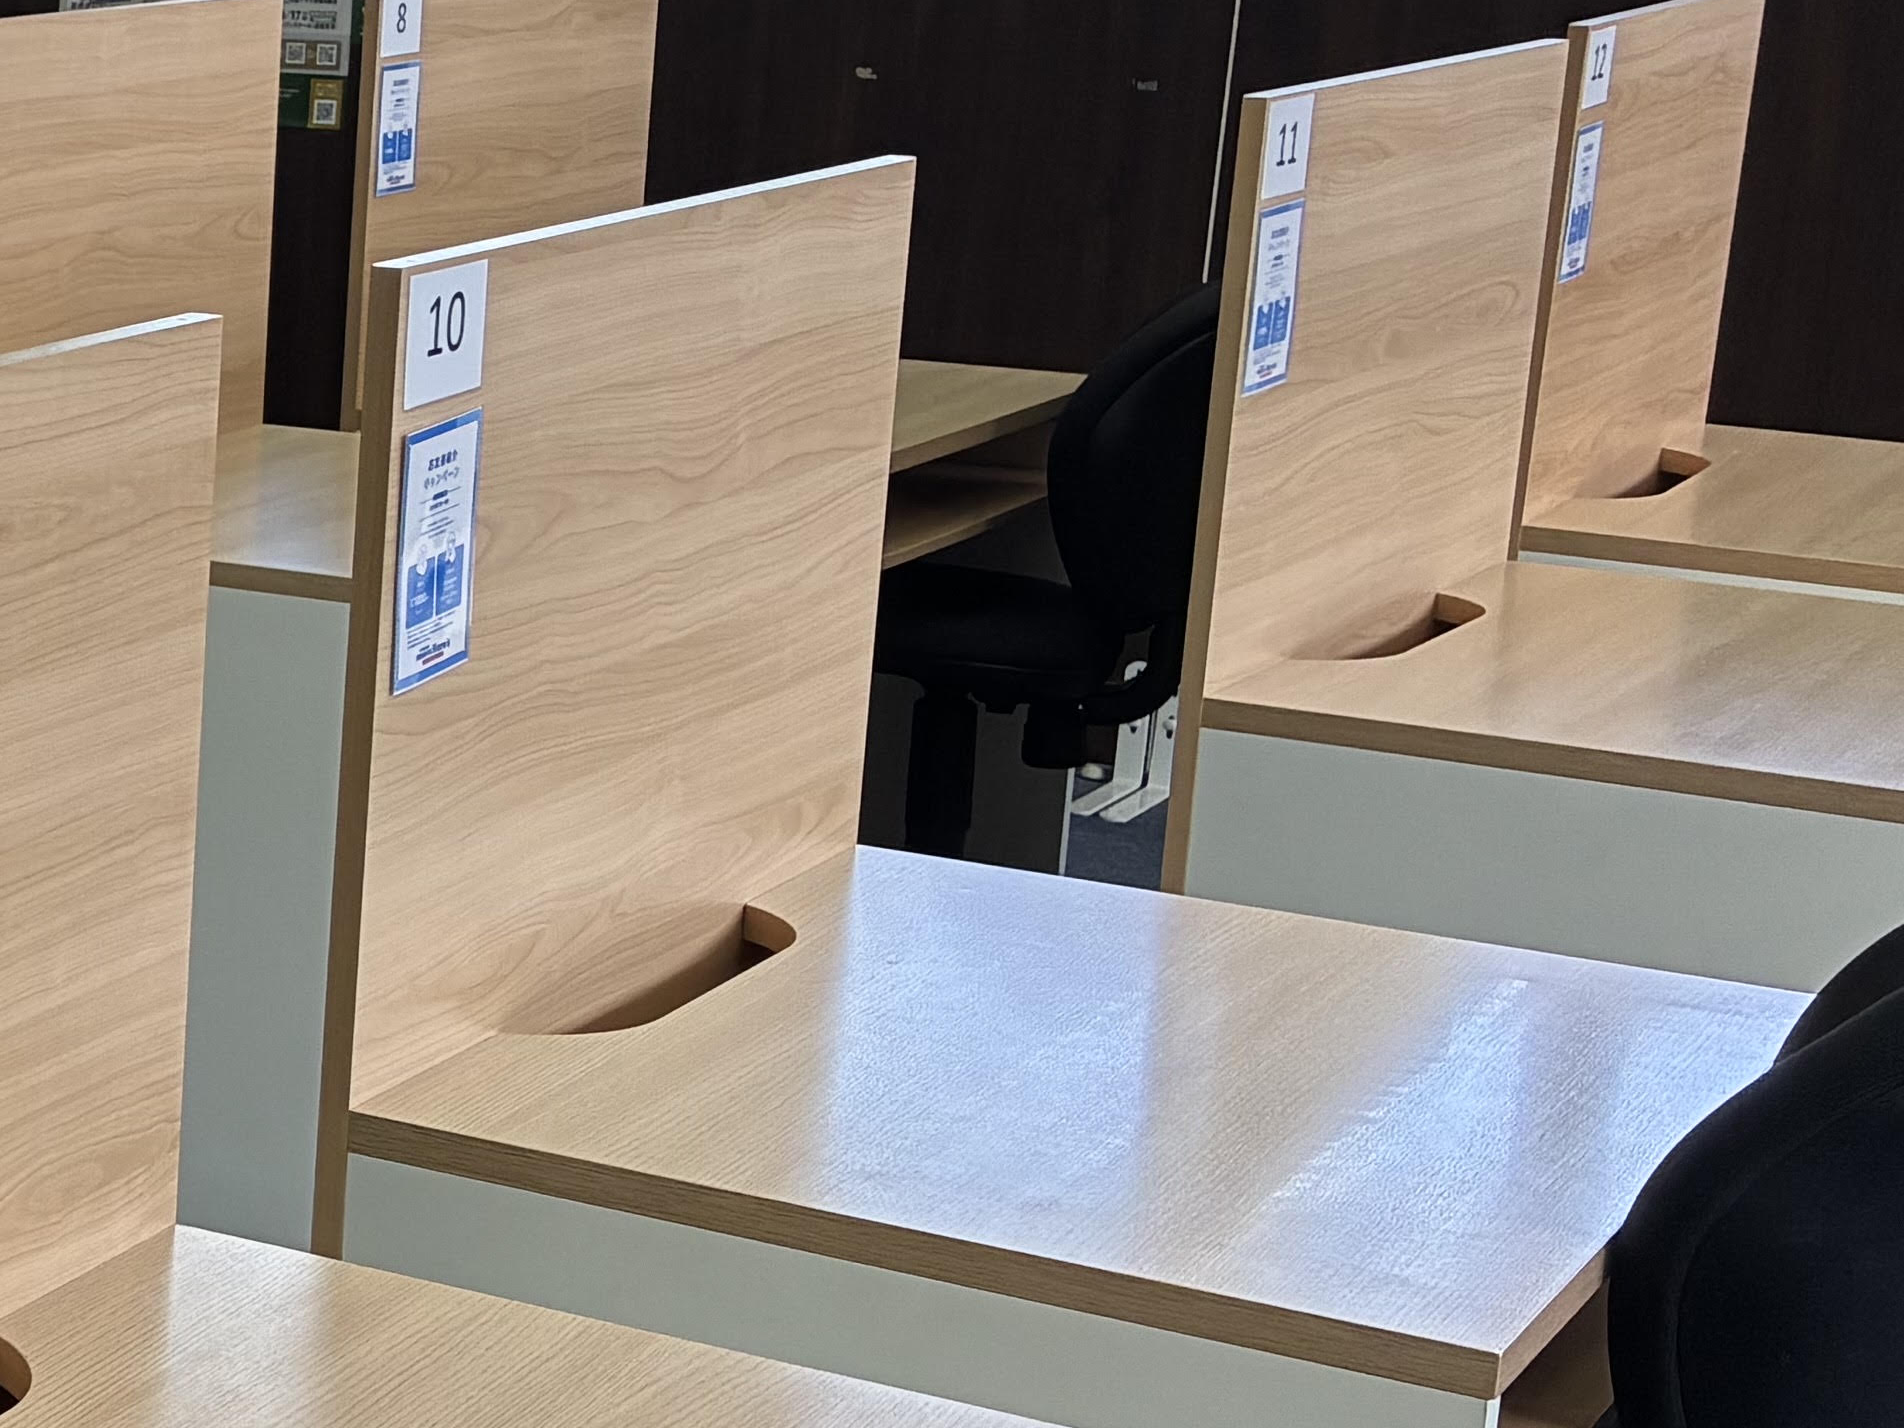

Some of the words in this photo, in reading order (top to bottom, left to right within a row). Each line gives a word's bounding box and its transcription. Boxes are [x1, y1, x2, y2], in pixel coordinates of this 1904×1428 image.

[396, 2, 407, 34] 8
[1275, 120, 1299, 168] 11
[426, 290, 466, 358] 10
